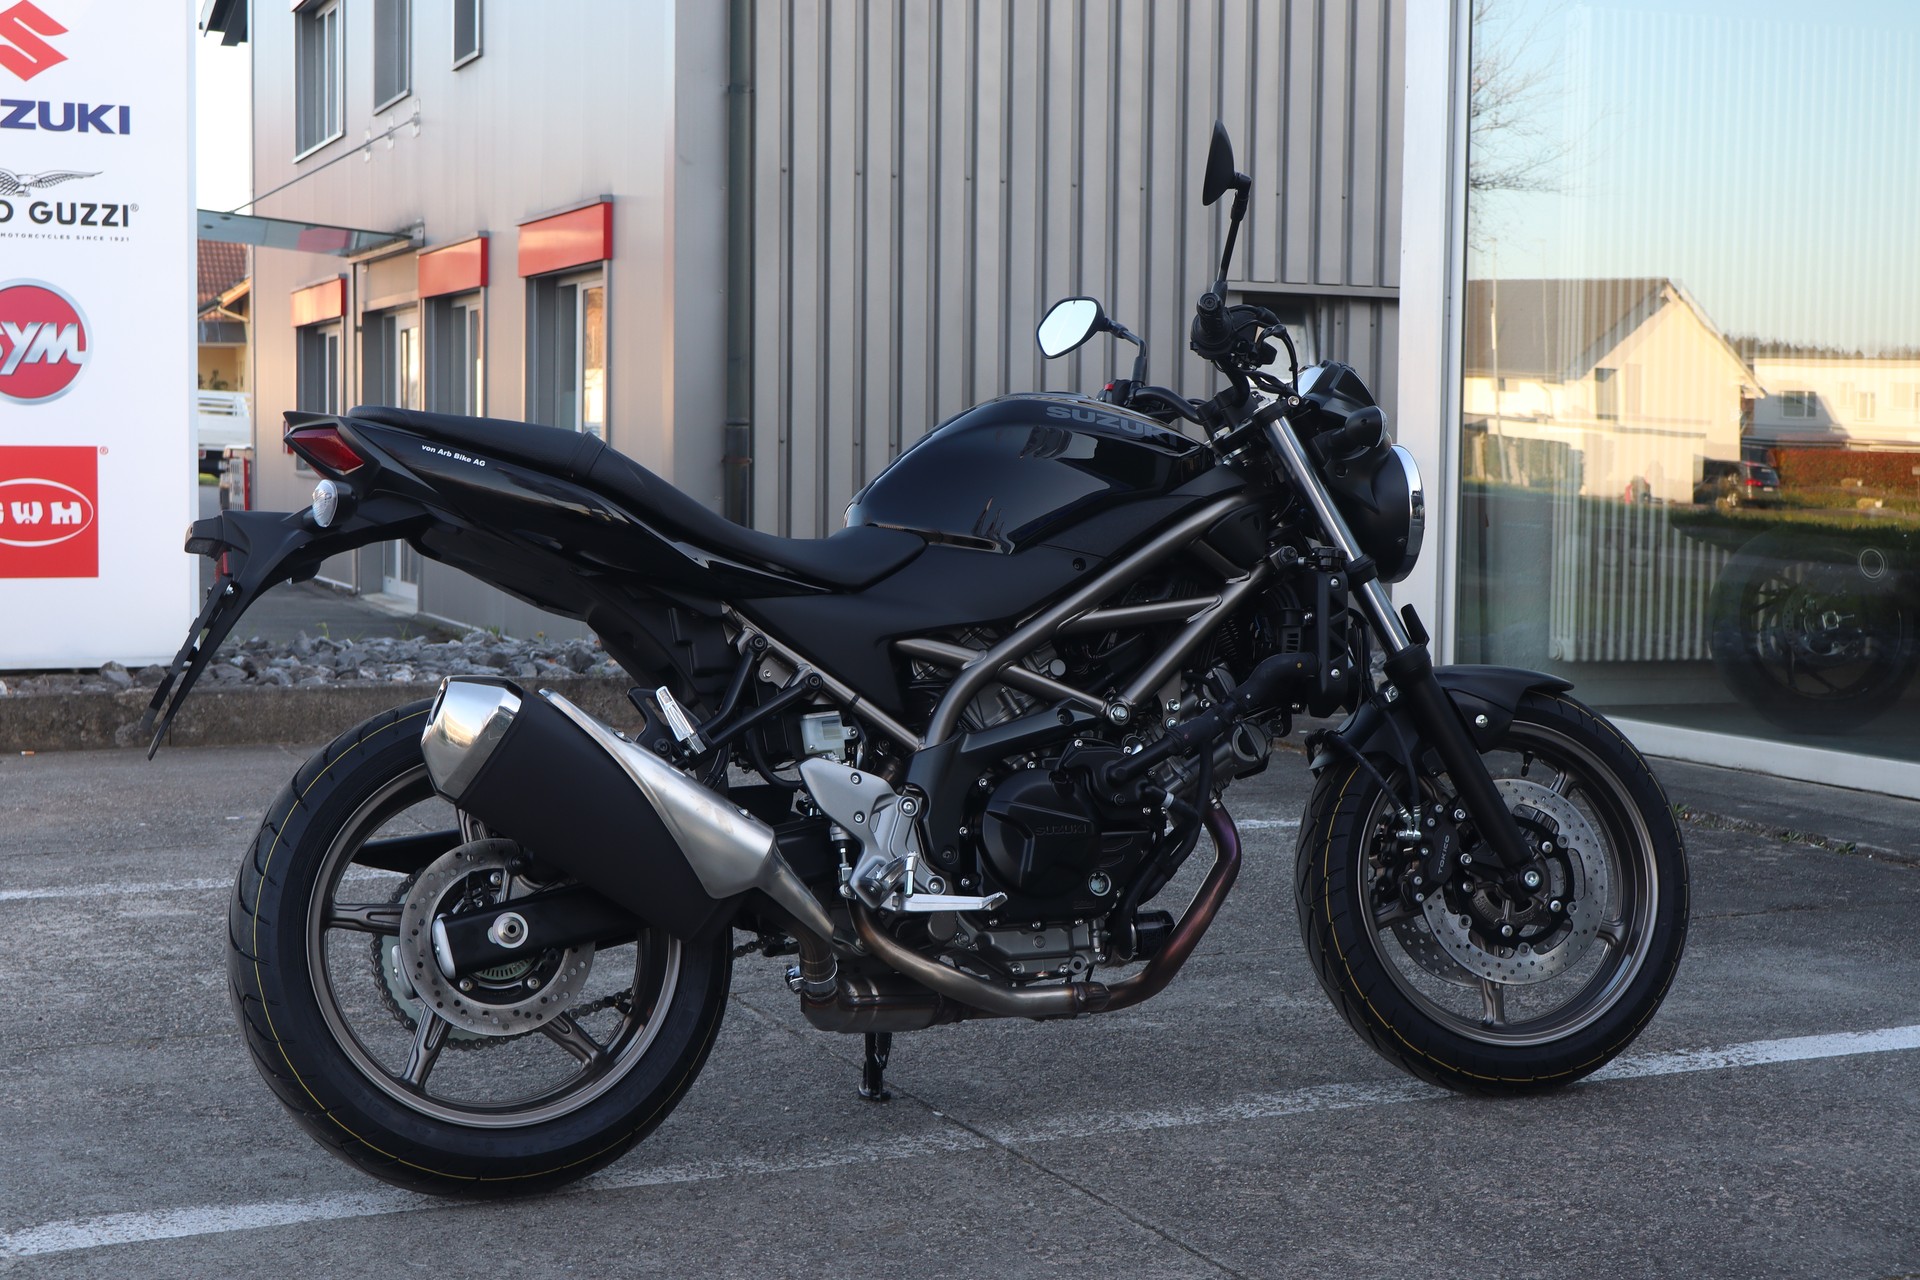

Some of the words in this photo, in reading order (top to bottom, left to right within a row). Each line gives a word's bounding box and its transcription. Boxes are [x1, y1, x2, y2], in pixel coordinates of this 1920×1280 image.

[1, 232, 71, 240] MOTORCYCLES
[0, 321, 86, 376] YM
[1046, 406, 1177, 447] SUZUKI
[421, 444, 436, 453] von
[437, 448, 452, 457] Arb
[453, 452, 472, 463] Bike
[473, 458, 486, 467] AG
[0, 501, 82, 525] WM
[1035, 823, 1087, 836] SUZUKI
[1437, 834, 1450, 875] TOKICO
